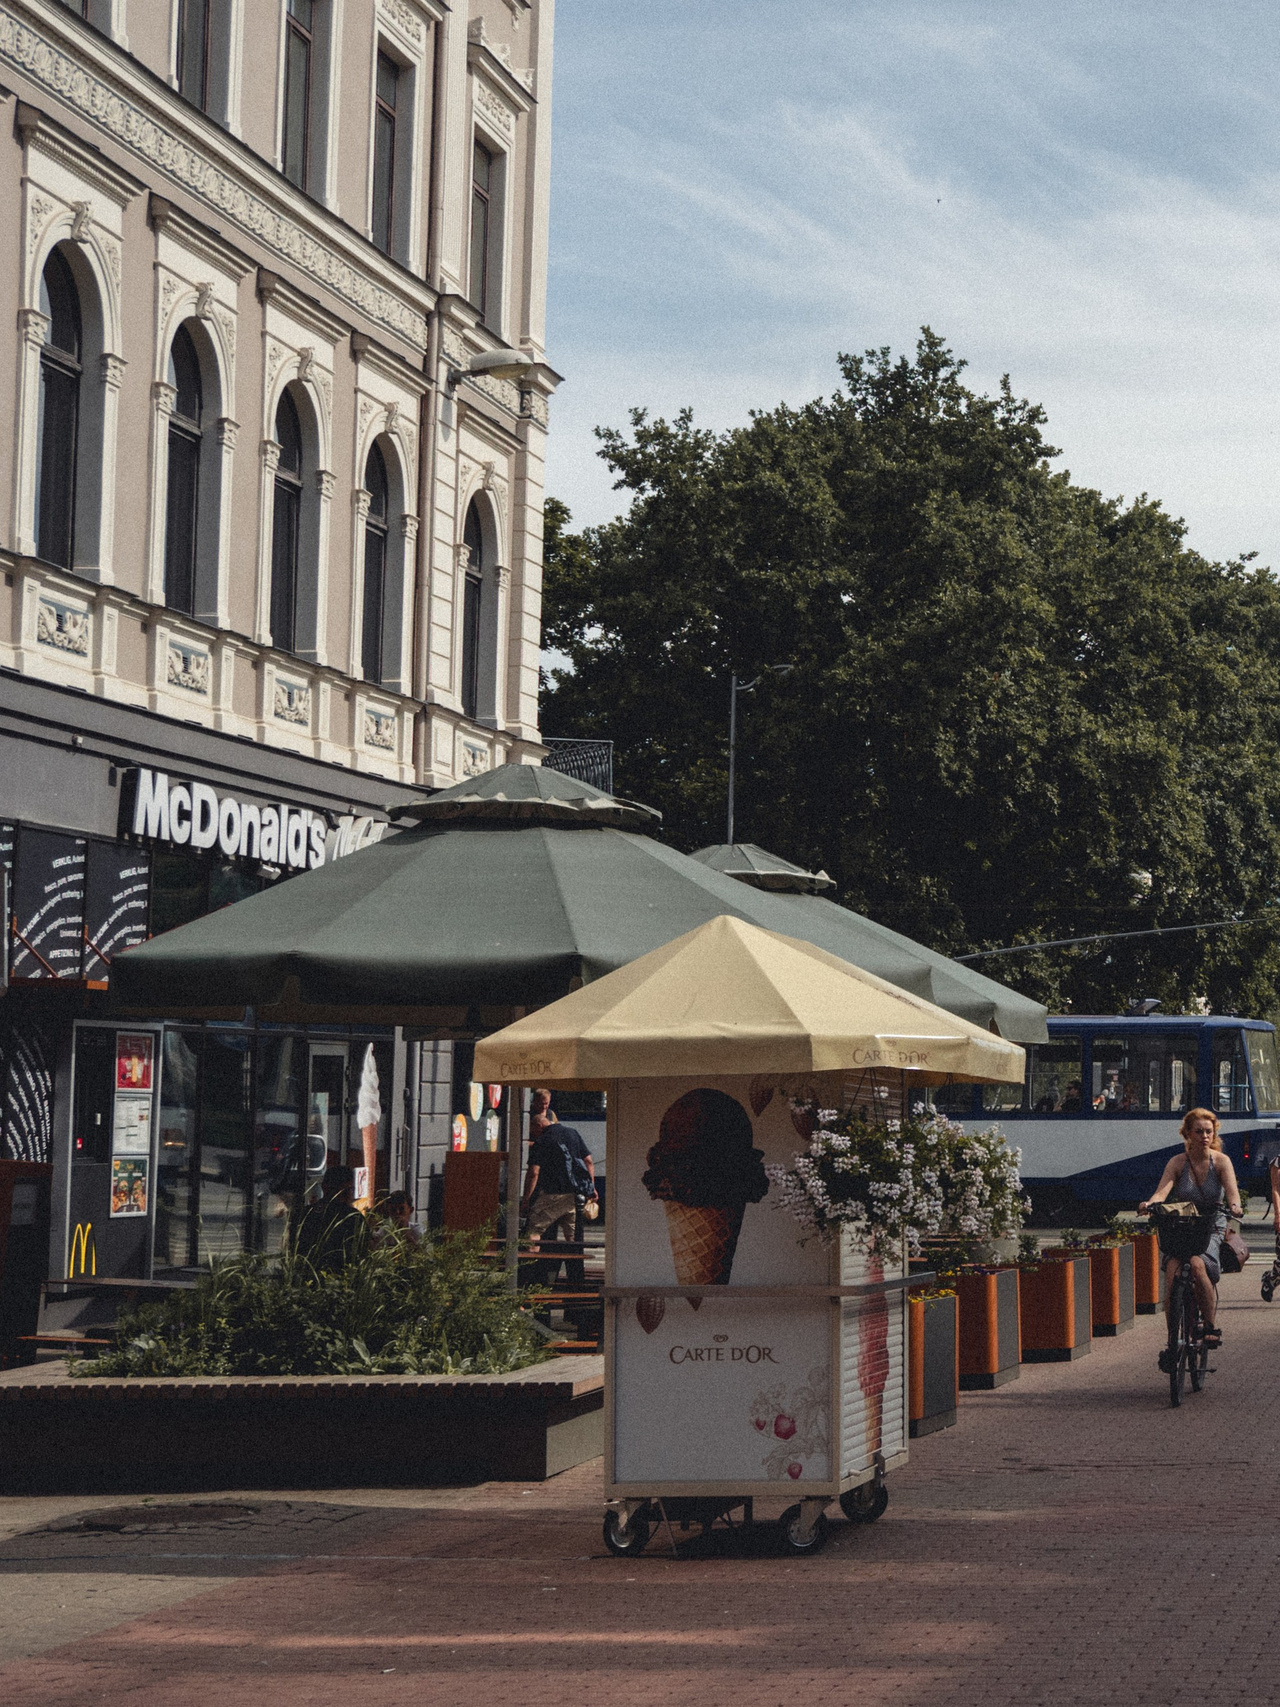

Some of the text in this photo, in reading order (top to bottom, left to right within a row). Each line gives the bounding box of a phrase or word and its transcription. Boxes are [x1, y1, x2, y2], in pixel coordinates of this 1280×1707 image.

[134, 768, 326, 870] McDonald's
[852, 1048, 897, 1065] CARTE
[501, 1062, 529, 1078] CARTE
[669, 1345, 780, 1365] CARTE D'OR
